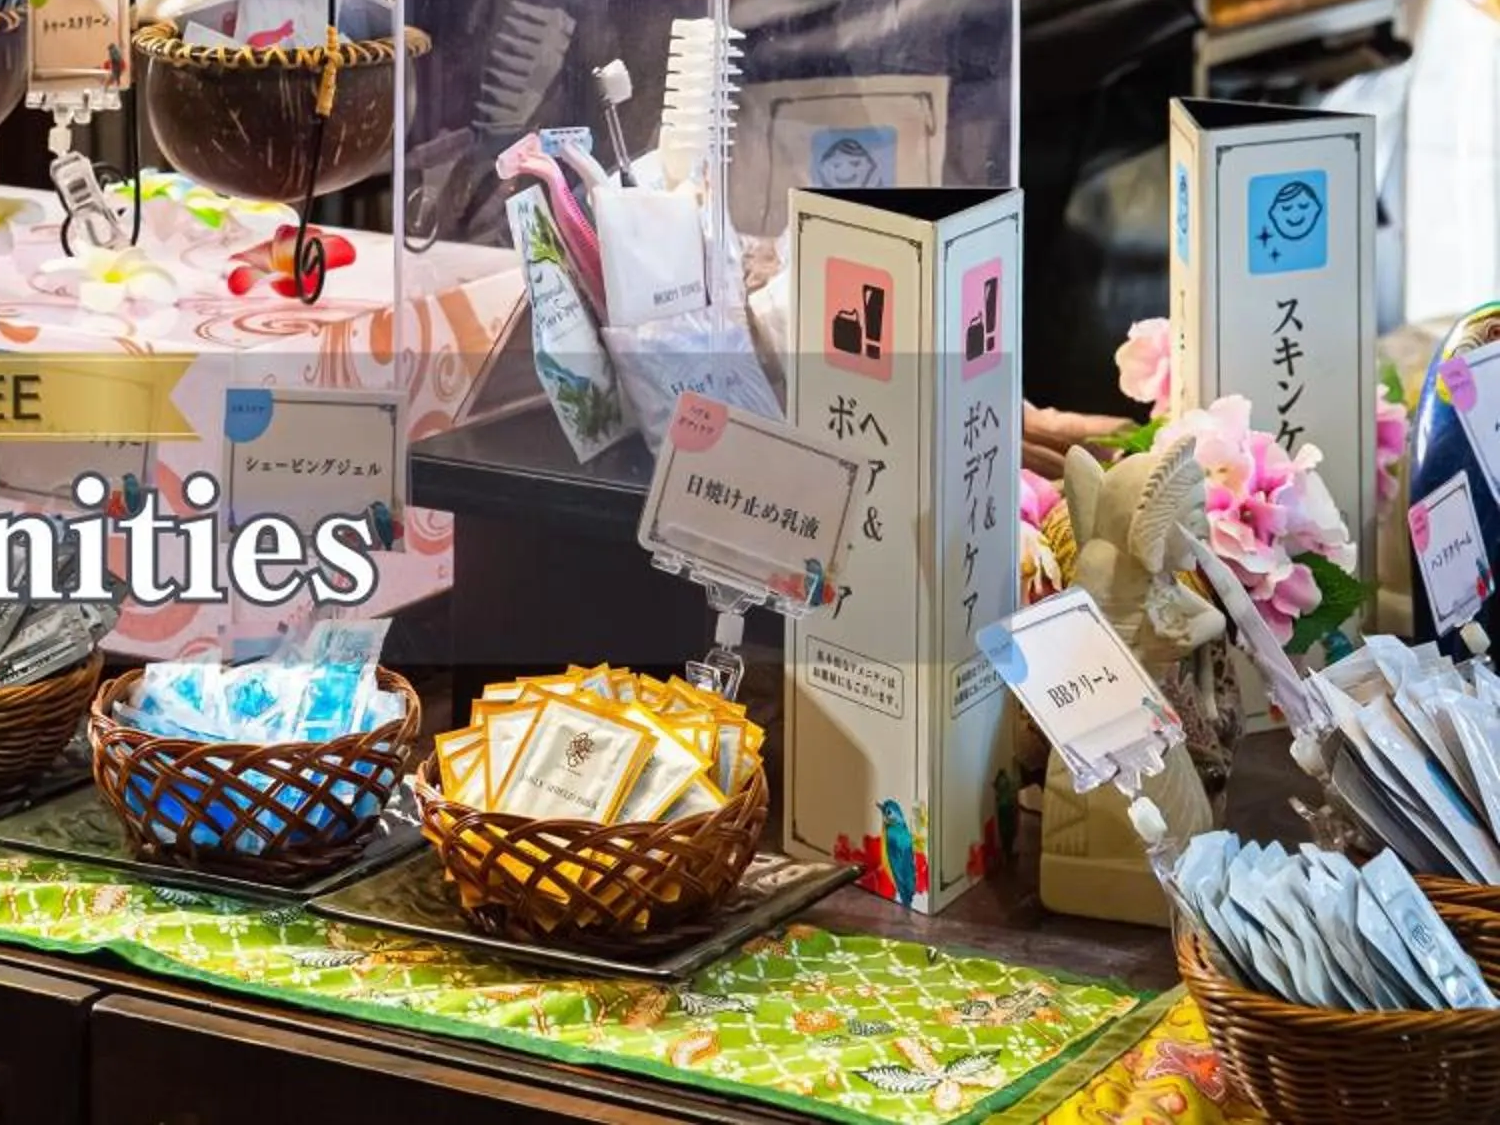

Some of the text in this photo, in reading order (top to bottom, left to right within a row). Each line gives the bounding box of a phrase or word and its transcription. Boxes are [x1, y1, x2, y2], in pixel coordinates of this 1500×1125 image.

[1271, 297, 1304, 453] スキンケ
[245, 456, 382, 476] シェービングジェル
[982, 405, 1000, 532] ヘア&
[684, 474, 822, 540] 日焼け止め乳液
[1046, 666, 1120, 710] BBクリーム
